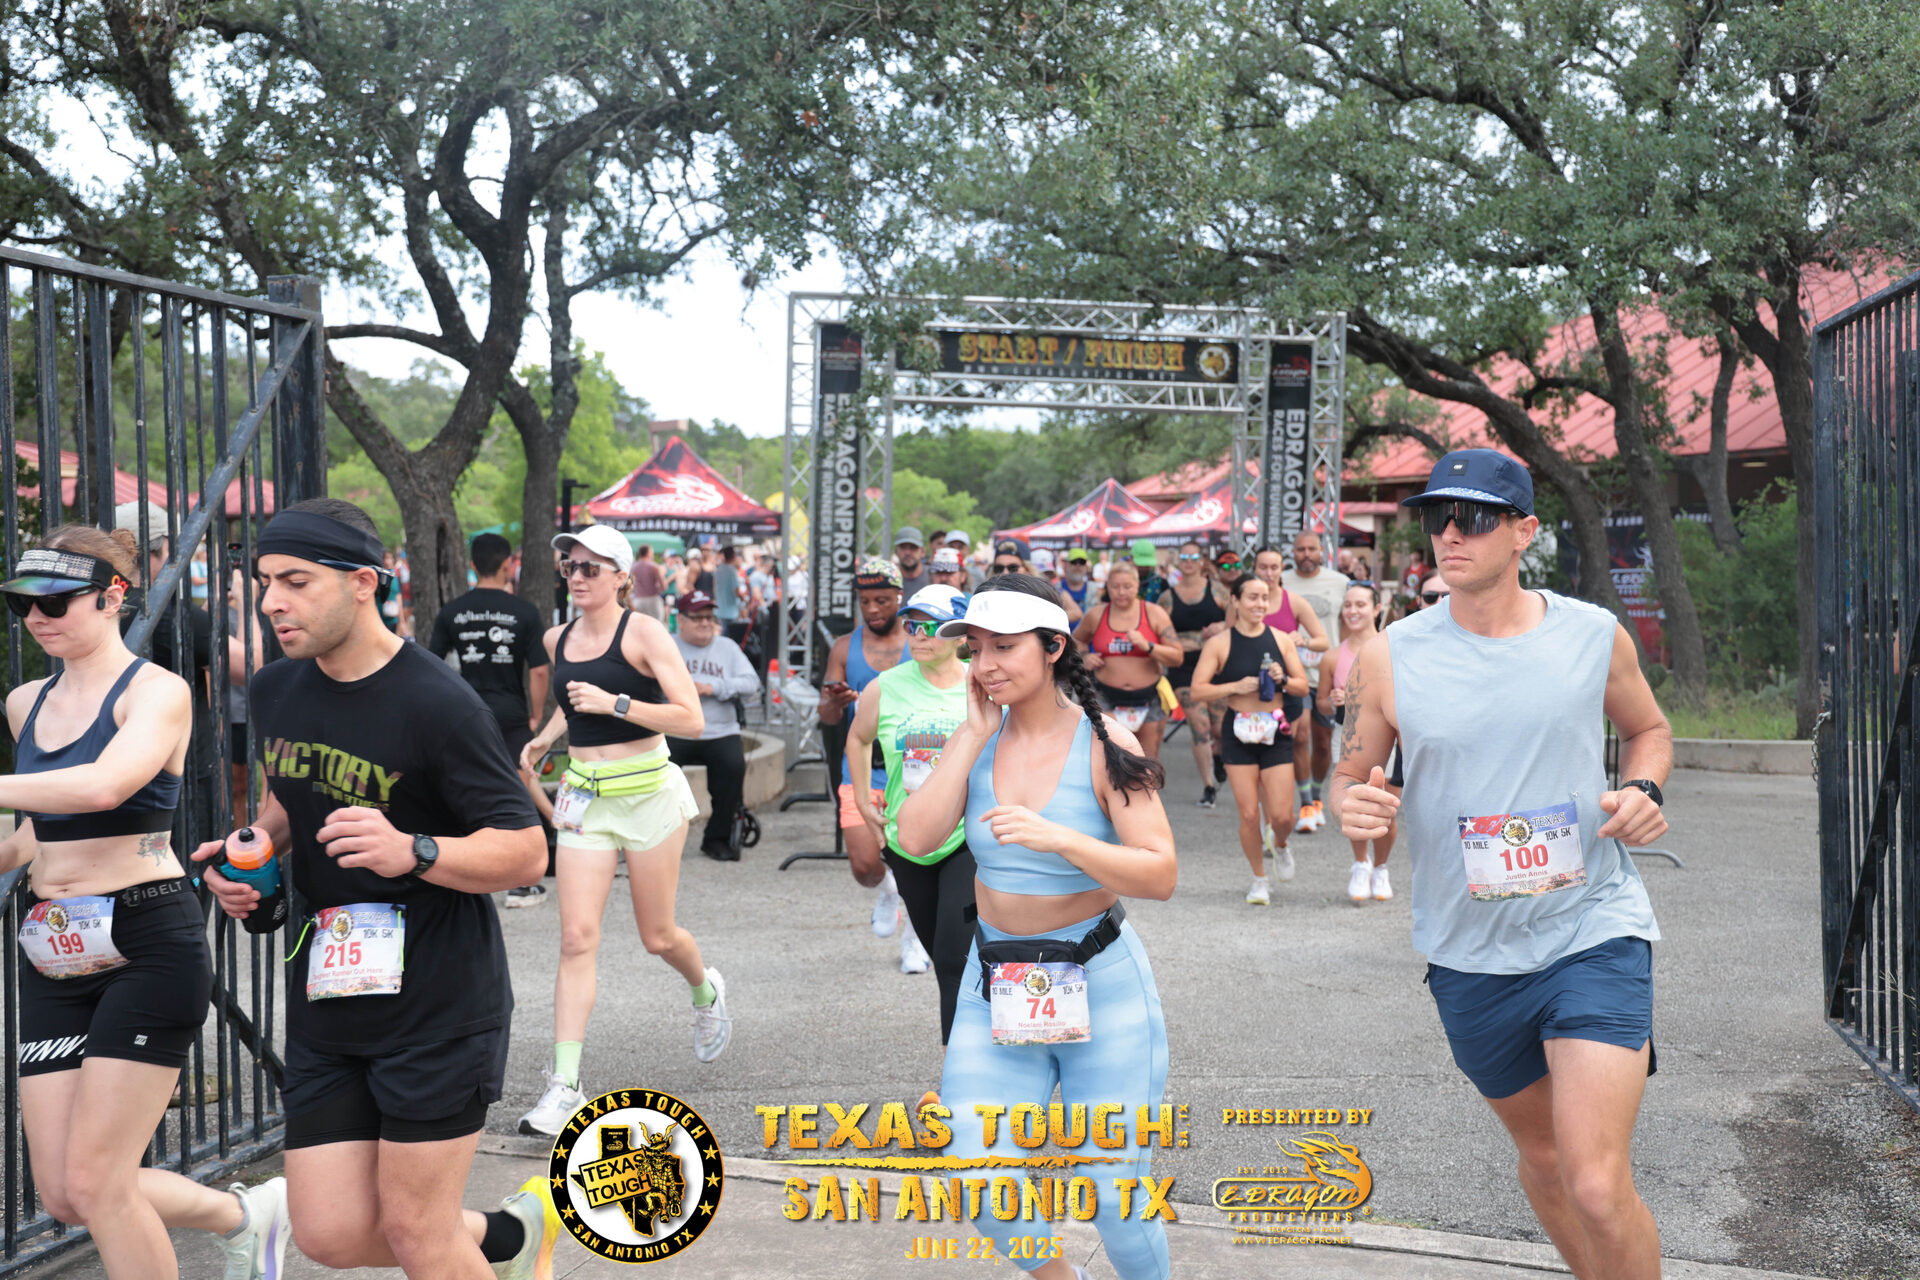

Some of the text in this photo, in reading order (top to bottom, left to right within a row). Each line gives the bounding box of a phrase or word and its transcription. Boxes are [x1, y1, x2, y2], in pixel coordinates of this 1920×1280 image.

[958, 333, 1059, 365] START
[1082, 339, 1186, 373] FINISH
[1267, 409, 1286, 544] RACES FOR RUNNERS
[264, 737, 405, 802] VICTORY
[1530, 812, 1567, 828] TEXAS
[1472, 841, 1490, 850] MILE
[1544, 826, 1572, 841] 10K 5K
[1499, 844, 1549, 872] 100
[1505, 869, 1549, 881] Justin Annis
[47, 932, 85, 956] 199
[324, 941, 362, 969] 215
[1026, 997, 1057, 1019] 74
